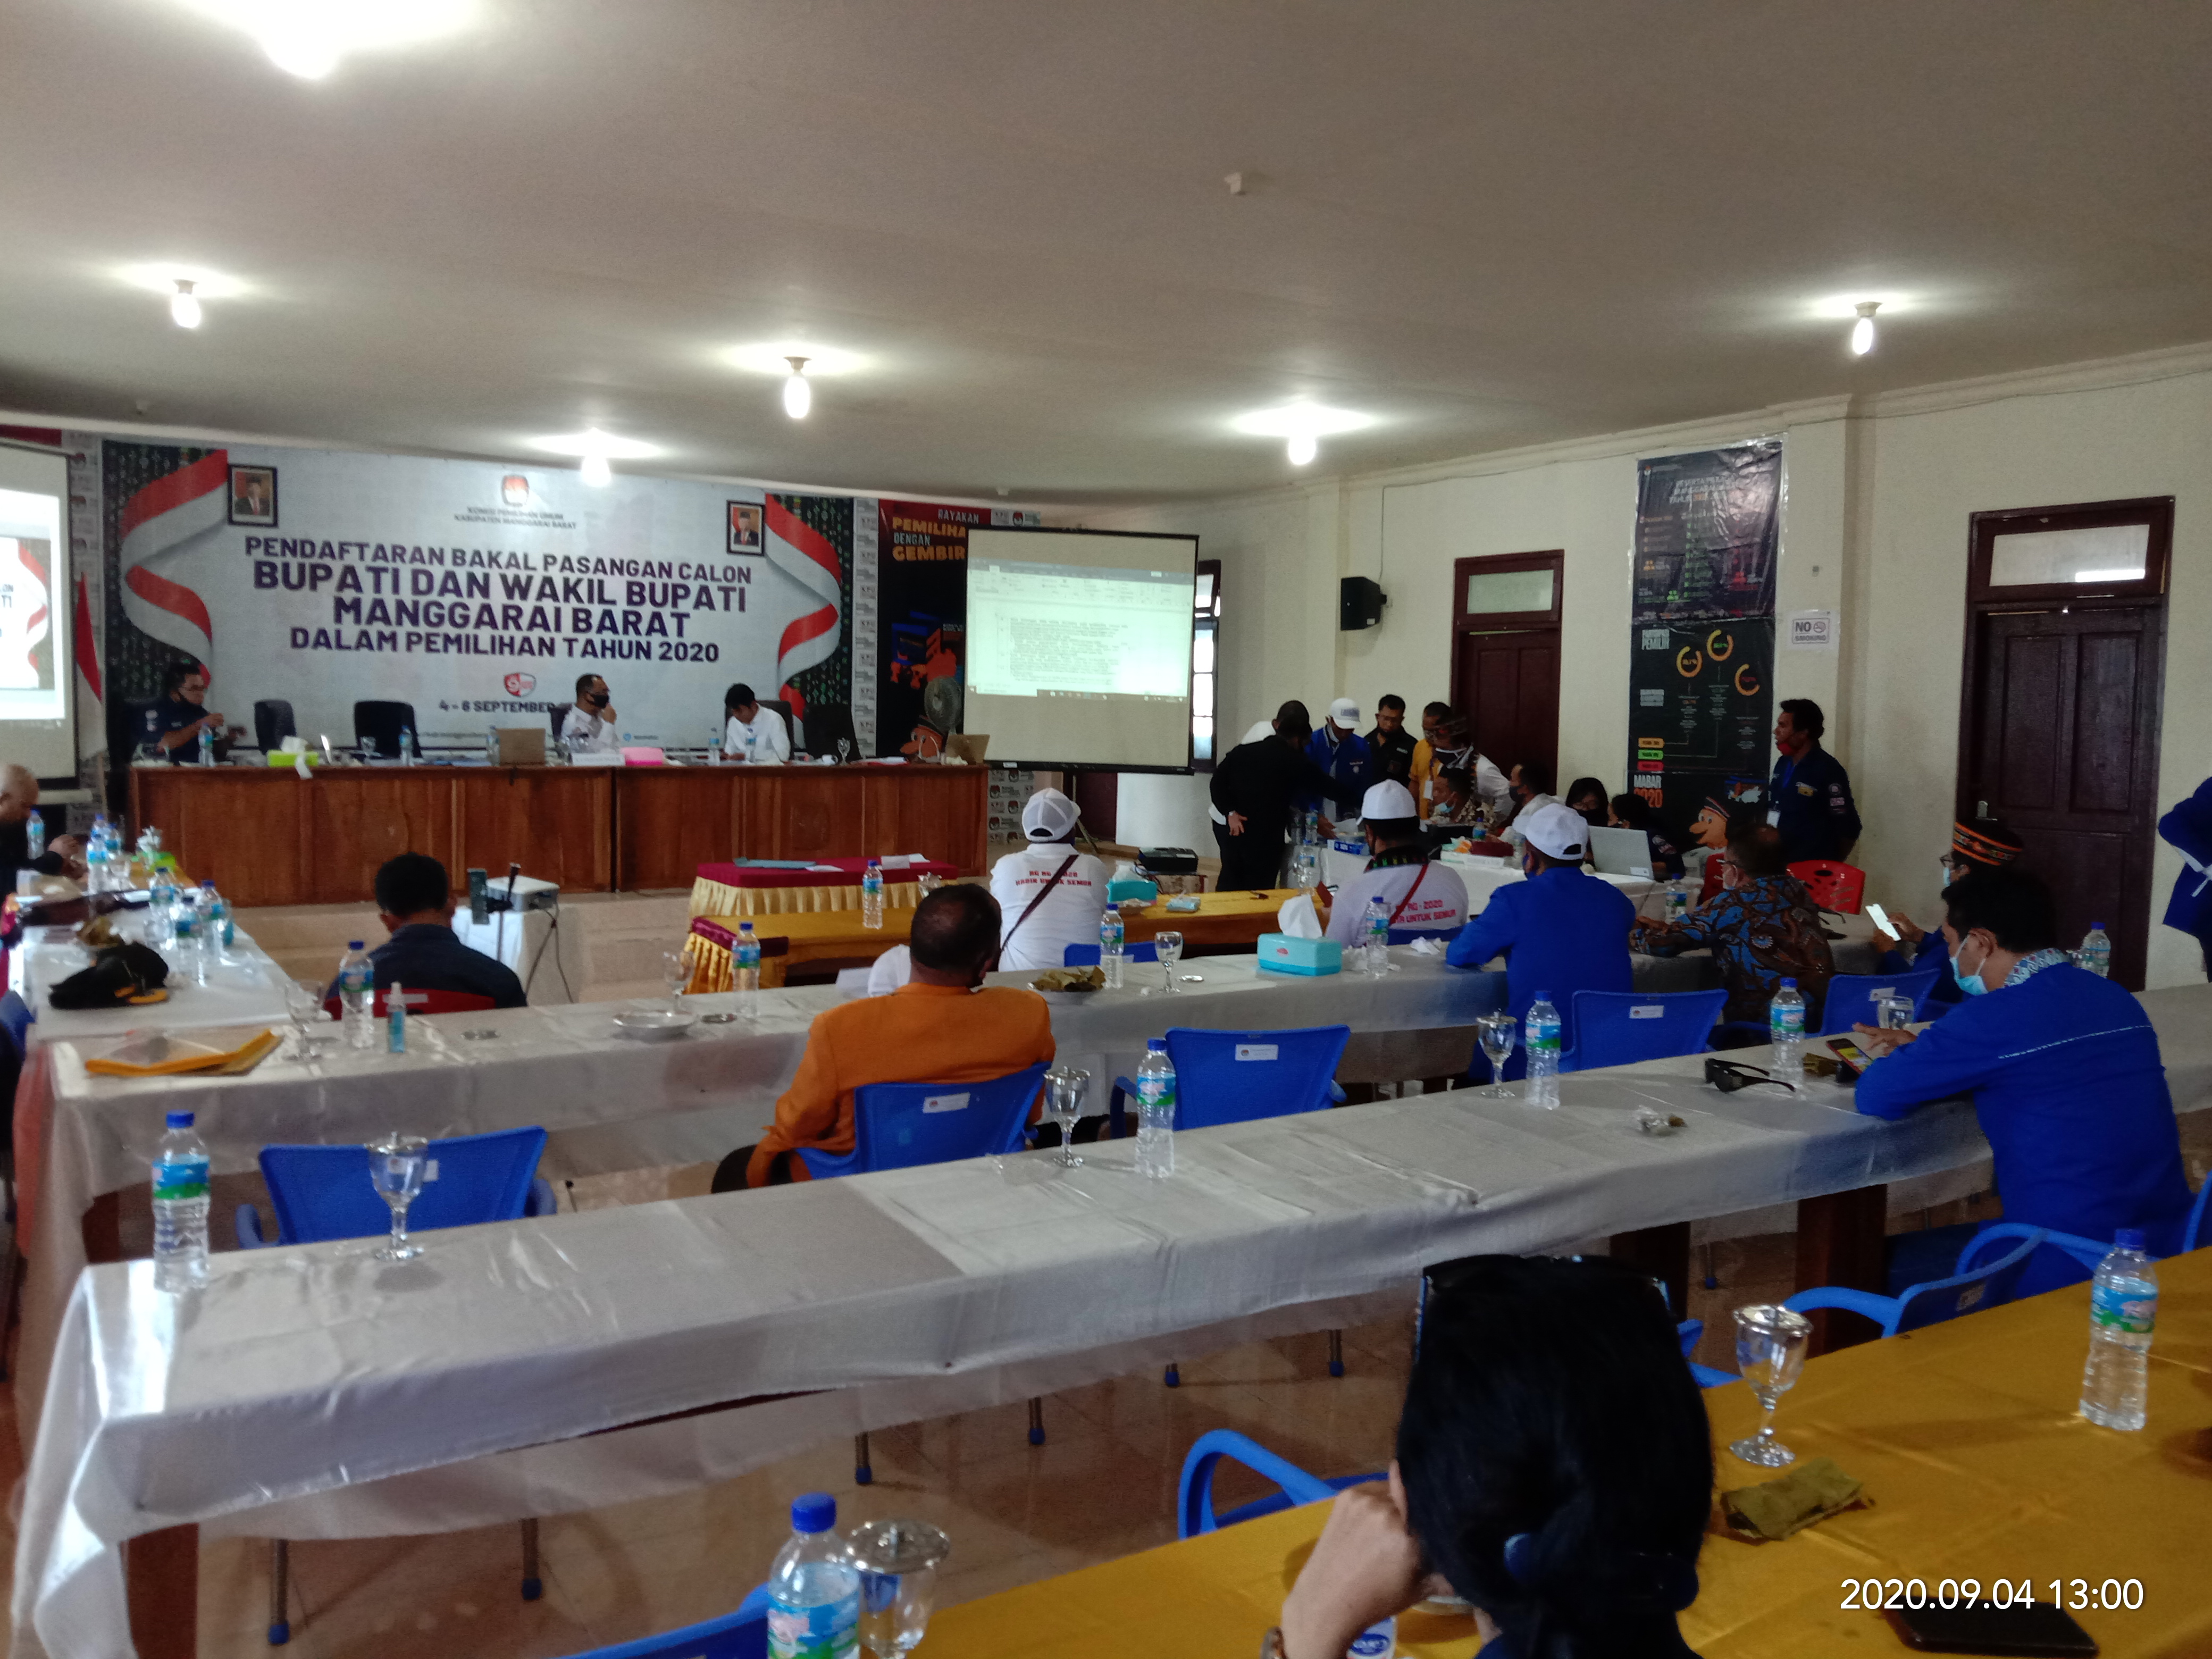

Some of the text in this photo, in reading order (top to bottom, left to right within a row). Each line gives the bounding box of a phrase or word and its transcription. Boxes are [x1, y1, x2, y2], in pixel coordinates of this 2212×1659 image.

[938, 508, 979, 525] RAYAKAN
[892, 517, 966, 538] PEMILIHA
[894, 532, 931, 546] DENGAN
[245, 535, 751, 584] PENDAFTARAN BAKAL PASANGAN CALON
[892, 545, 966, 561] GEMBIR
[254, 560, 746, 613] BUPATI DAN WAKIL BUPATI
[333, 597, 691, 638] MANGGARAI BARAT
[1795, 621, 1812, 632] NO
[290, 627, 719, 663] DALAM PEMILIHAN TAHUN 2020
[439, 700, 449, 711] 4
[1634, 774, 1662, 789] MABAR
